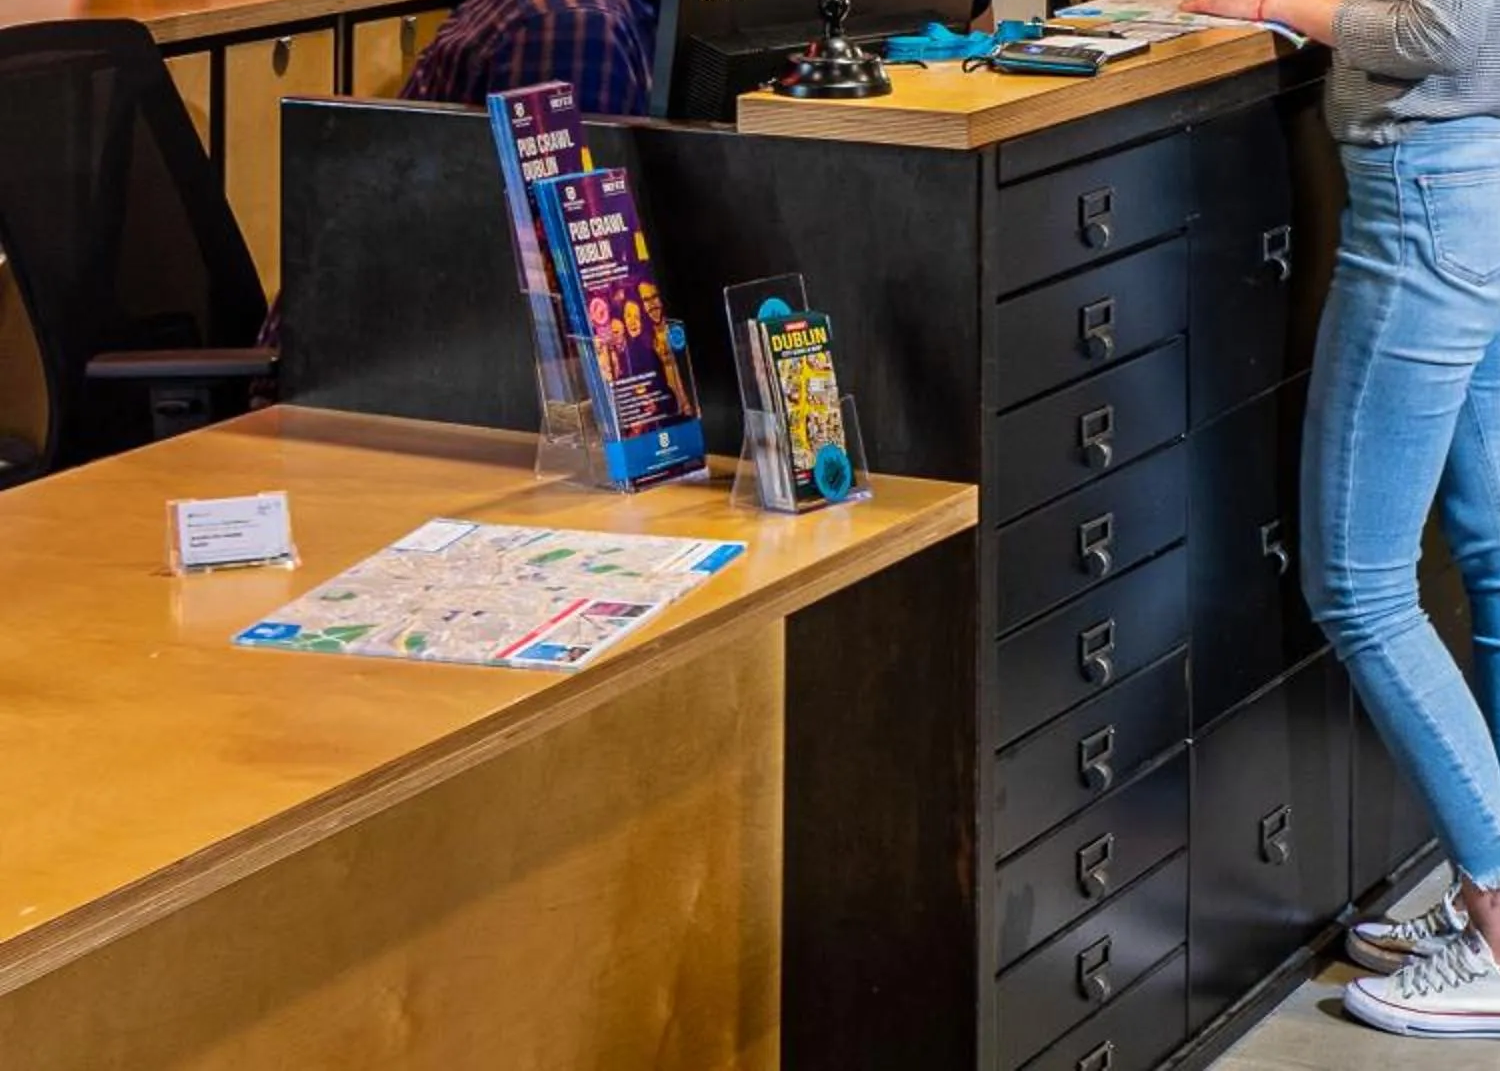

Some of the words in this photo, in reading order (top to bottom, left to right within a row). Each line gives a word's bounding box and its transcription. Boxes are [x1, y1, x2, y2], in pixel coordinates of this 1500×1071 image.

[517, 136, 538, 158] PUB
[537, 128, 575, 153] CRAWL
[568, 220, 591, 242] PUB
[590, 212, 629, 238] CRAWL
[575, 239, 613, 266] DUBLIN
[771, 326, 827, 352] DUBLIN
